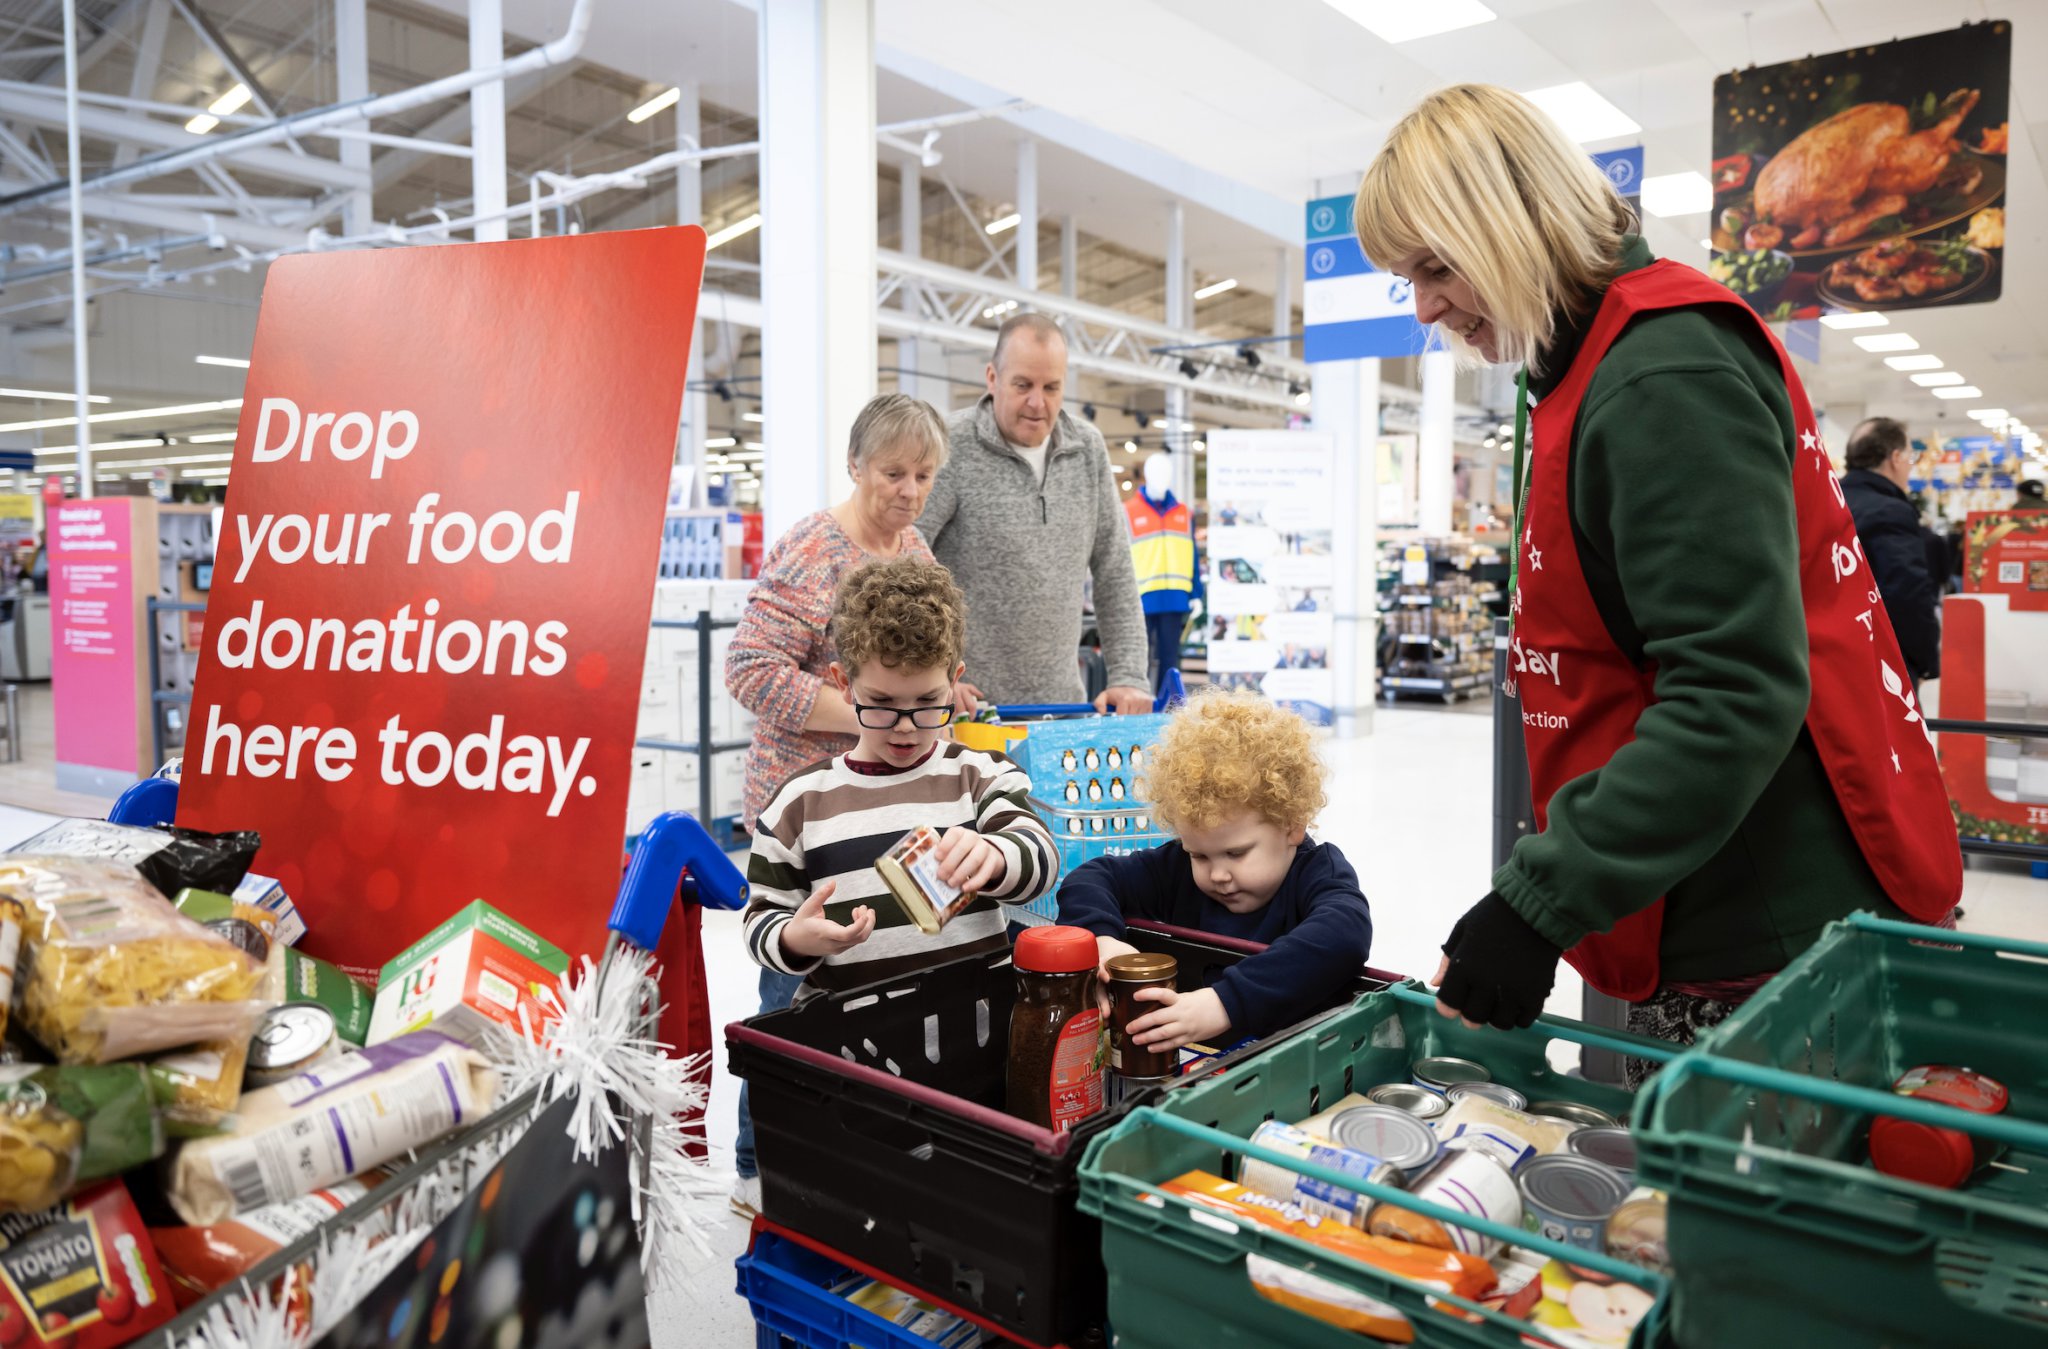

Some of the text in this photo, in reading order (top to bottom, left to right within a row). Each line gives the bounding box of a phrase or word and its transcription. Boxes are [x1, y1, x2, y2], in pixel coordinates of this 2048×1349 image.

[251, 396, 420, 479] Drop
[233, 490, 581, 583] your food
[216, 598, 569, 677] donations
[201, 704, 597, 817] here today.
[398, 954, 441, 1009] PG
[8, 1234, 92, 1283] TOMATO
